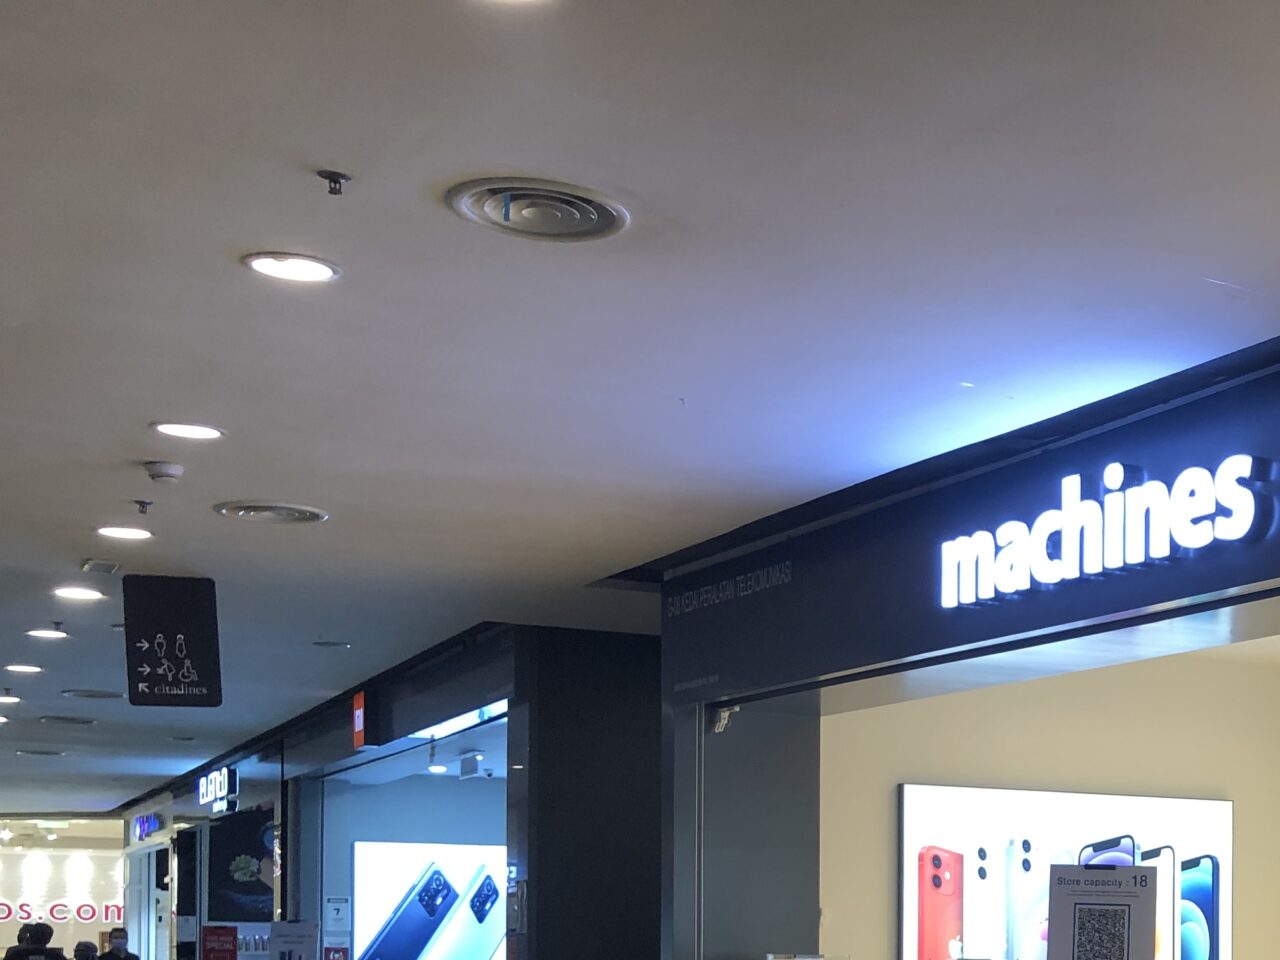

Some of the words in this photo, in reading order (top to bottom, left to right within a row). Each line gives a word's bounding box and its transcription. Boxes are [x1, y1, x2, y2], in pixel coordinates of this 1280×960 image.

[941, 453, 1256, 609] machines
[154, 683, 207, 695] citadines
[1056, 876, 1081, 886] Store
[1084, 878, 1123, 889] capacity
[1131, 874, 1148, 888] 18
